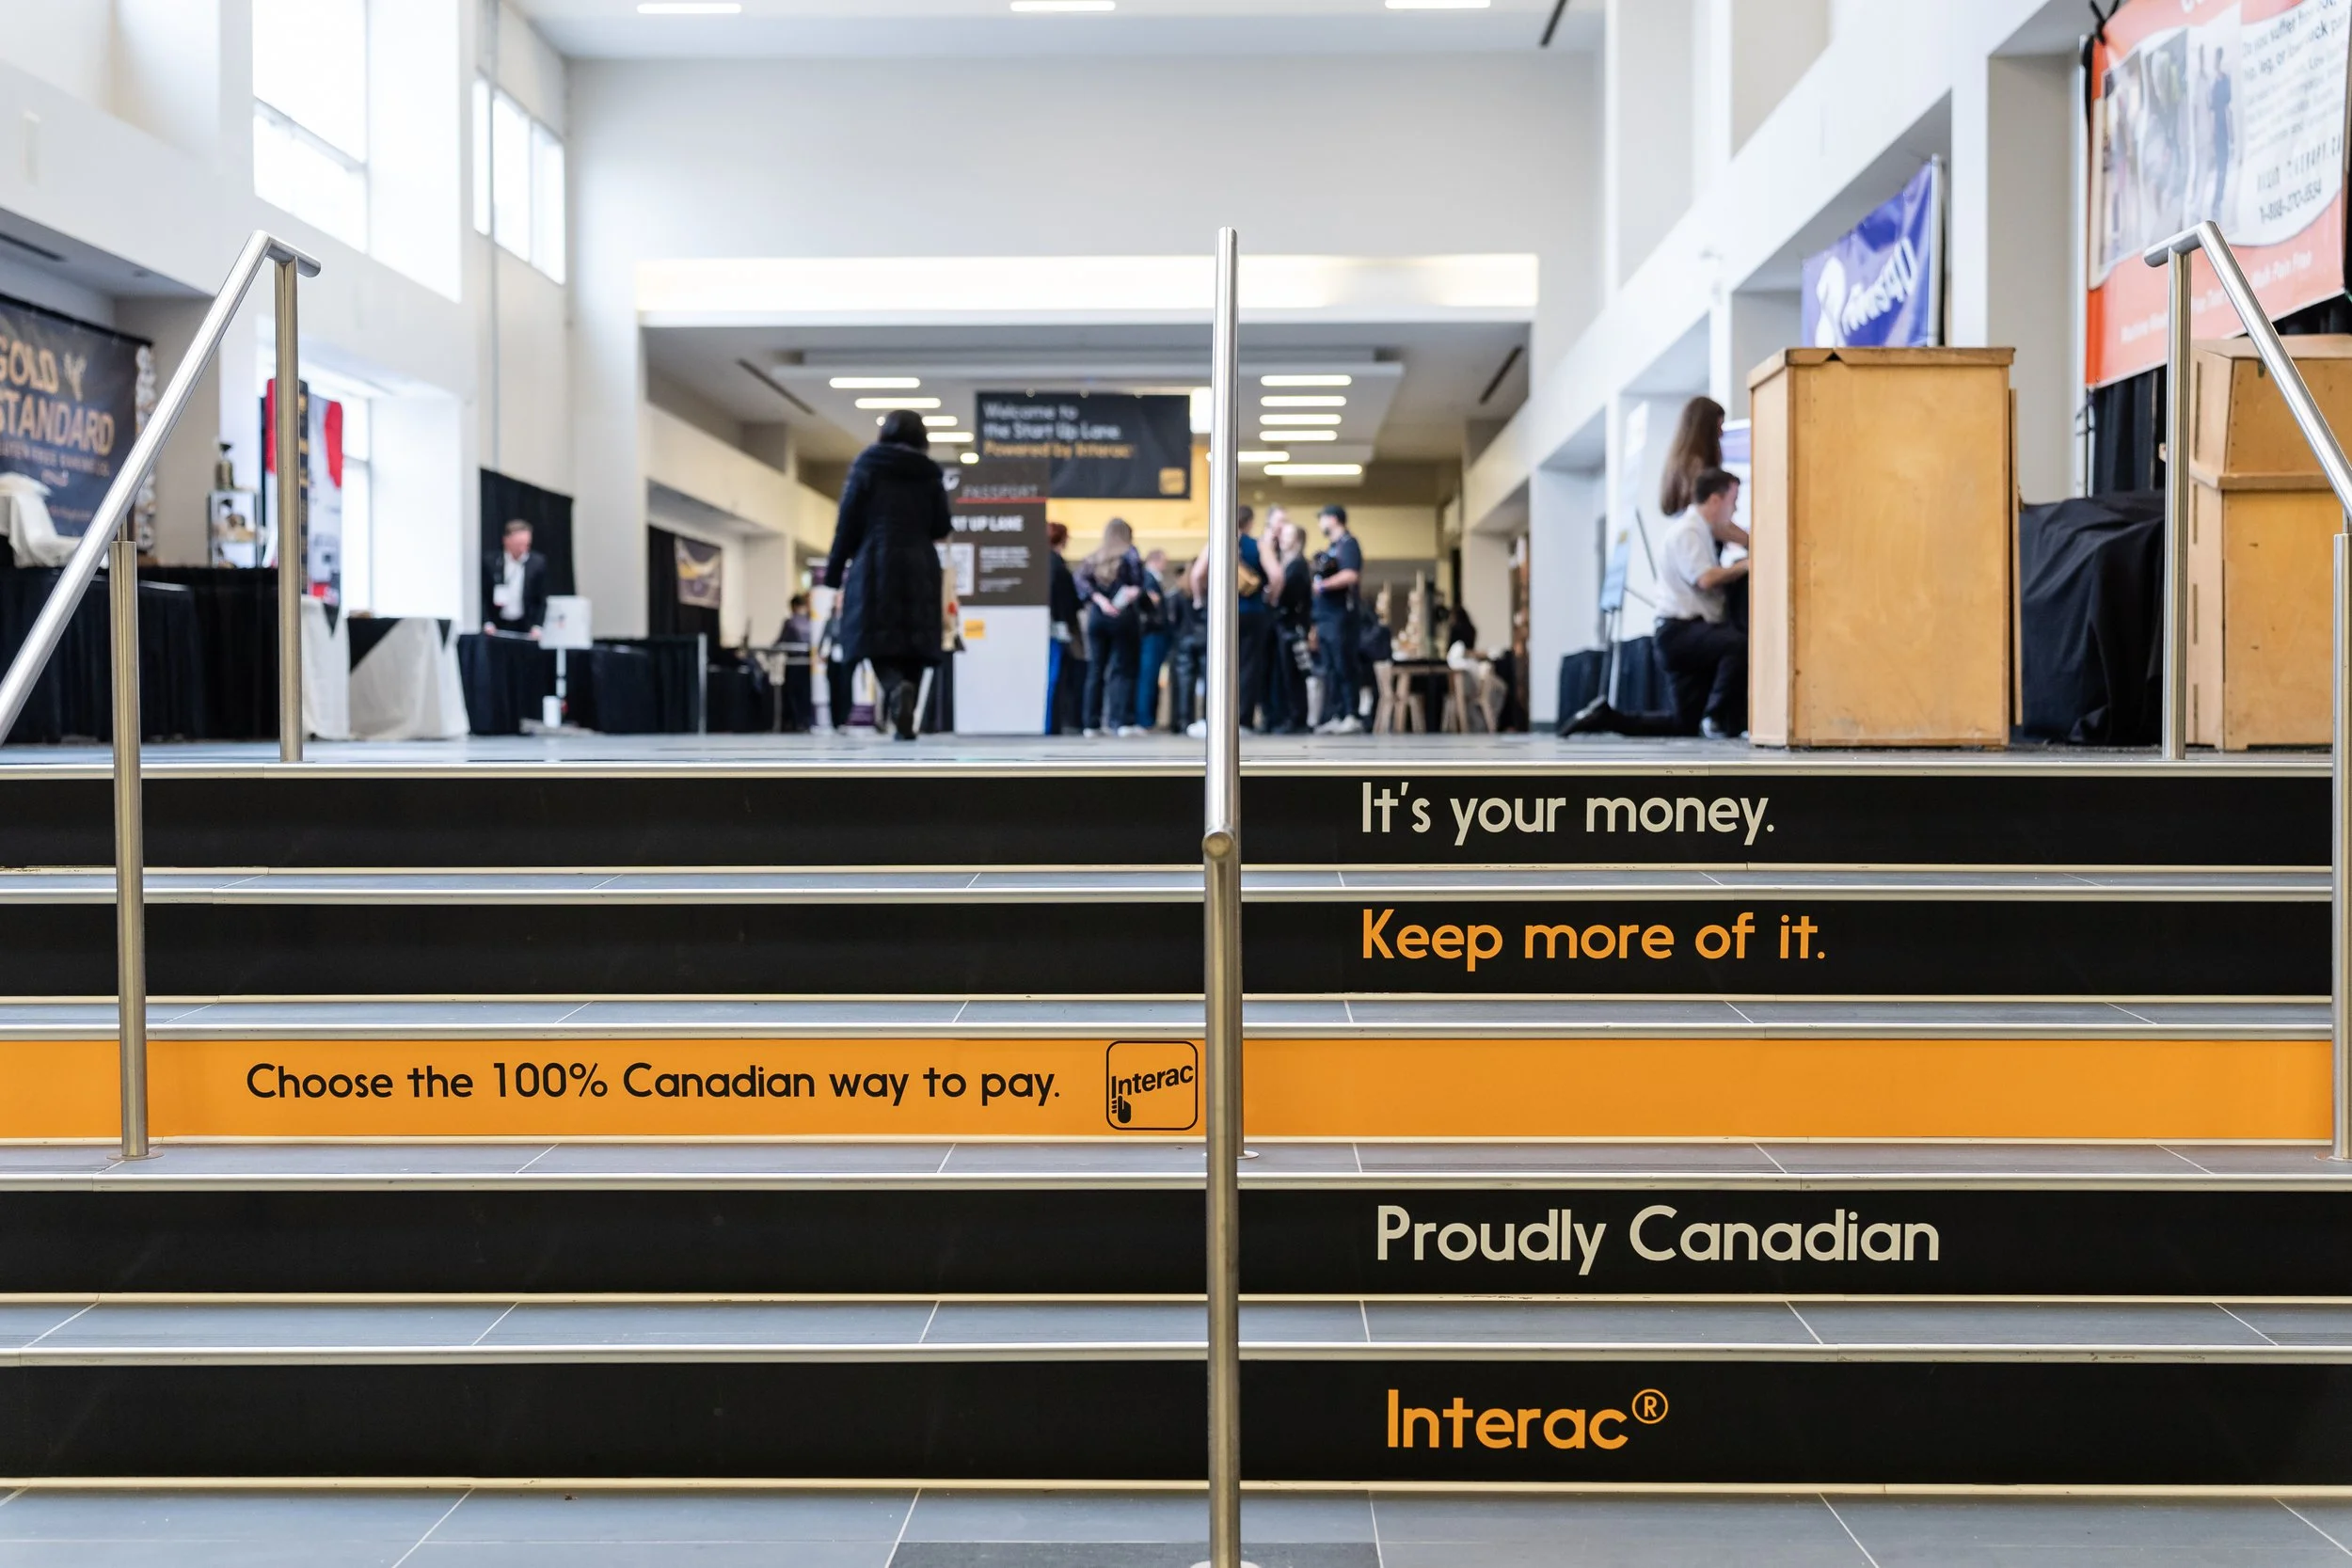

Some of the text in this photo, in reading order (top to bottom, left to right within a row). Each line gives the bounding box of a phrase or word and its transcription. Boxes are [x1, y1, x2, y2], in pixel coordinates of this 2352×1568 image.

[983, 402, 1079, 420] Welcome to
[983, 421, 1011, 439] the
[1012, 422, 1054, 439] Start
[1056, 423, 1078, 441] Up
[984, 440, 1051, 458] Powered
[1053, 443, 1073, 460] by
[968, 515, 988, 532] UP
[989, 515, 1024, 532] LANE
[1362, 783, 1774, 846] It's your money.
[1362, 909, 1826, 972] Keep more of it.
[246, 1062, 1060, 1107] Choose the 100% Canadian way to pay.
[1111, 1065, 1194, 1100] Interac
[1377, 1204, 1939, 1275] Proudly Canadian
